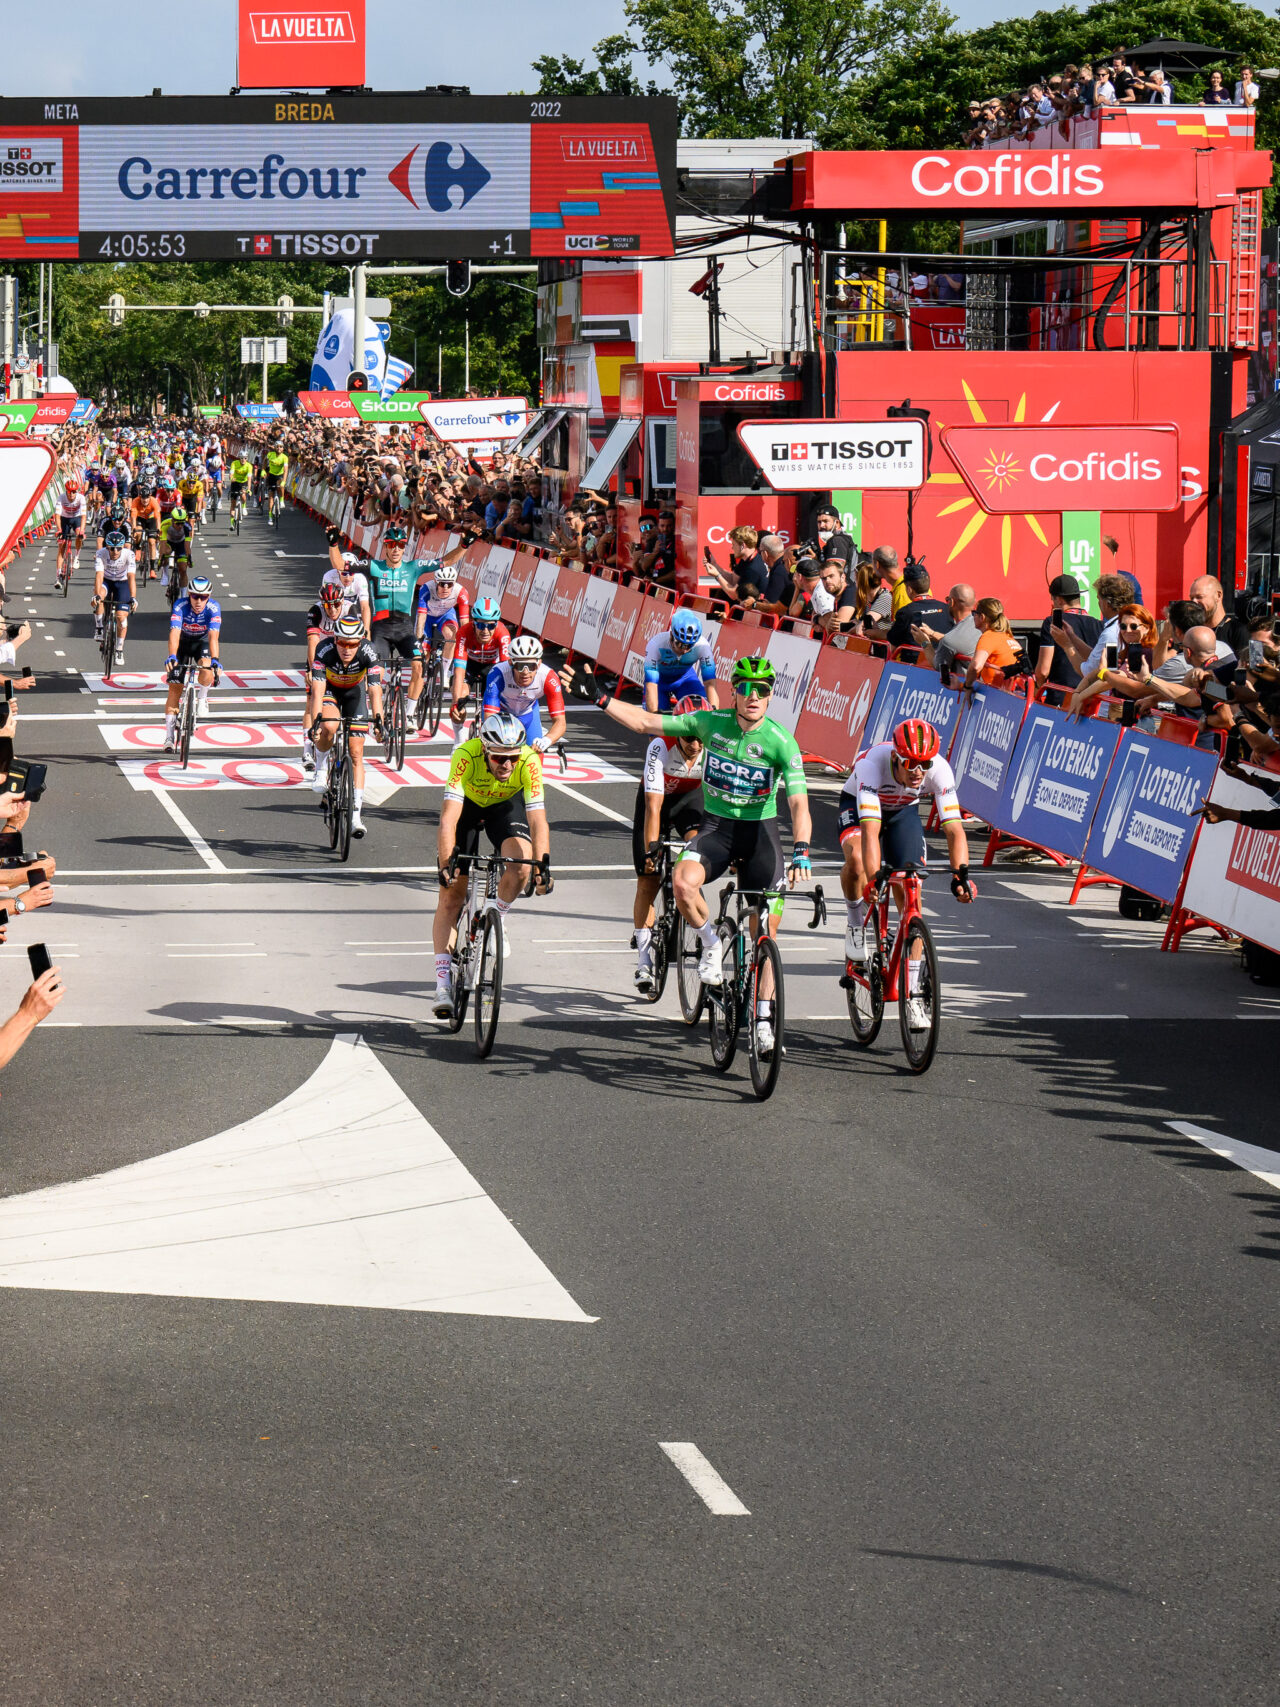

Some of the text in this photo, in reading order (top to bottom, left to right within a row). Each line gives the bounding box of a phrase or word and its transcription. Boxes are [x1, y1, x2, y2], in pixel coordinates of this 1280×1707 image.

[261, 17, 345, 38] LA VUELTA
[44, 103, 80, 119] META
[274, 103, 335, 121] BREDA
[530, 102, 562, 117] 2022
[569, 140, 638, 157] LA VUELTA
[117, 153, 367, 201] Carrefour
[911, 153, 1105, 197] Cofidis
[98, 233, 186, 257] 4:05:53
[274, 234, 380, 255] TISSOT
[488, 233, 517, 255] +1
[568, 237, 593, 249] UCI
[714, 384, 786, 401] Cofidis
[37, 406, 67, 416] ofidis
[434, 414, 492, 427] Carrefour
[811, 440, 913, 460] TISSOT
[771, 461, 914, 472] SWISS WATCHES SINCE 1853
[1029, 452, 1162, 482] Cofidis
[379, 578, 409, 587] BORA
[773, 662, 795, 700] efour
[806, 676, 850, 722] Carrefour
[898, 688, 954, 727] LOTERÍAS
[977, 710, 1015, 752] LOTERÍAS
[646, 744, 661, 783] Cofidis
[708, 756, 766, 782] BORA
[1045, 735, 1104, 781] LOTERÍAS
[448, 757, 470, 790] ARKEA
[526, 762, 541, 798] ARKEA
[709, 768, 764, 787] hansgrohe
[1039, 785, 1086, 816] CON EL DEPORTE
[1139, 765, 1201, 817] LOTERÍAS
[1131, 818, 1178, 853] CON EL DEPORTE
[1232, 825, 1250, 876] LA
